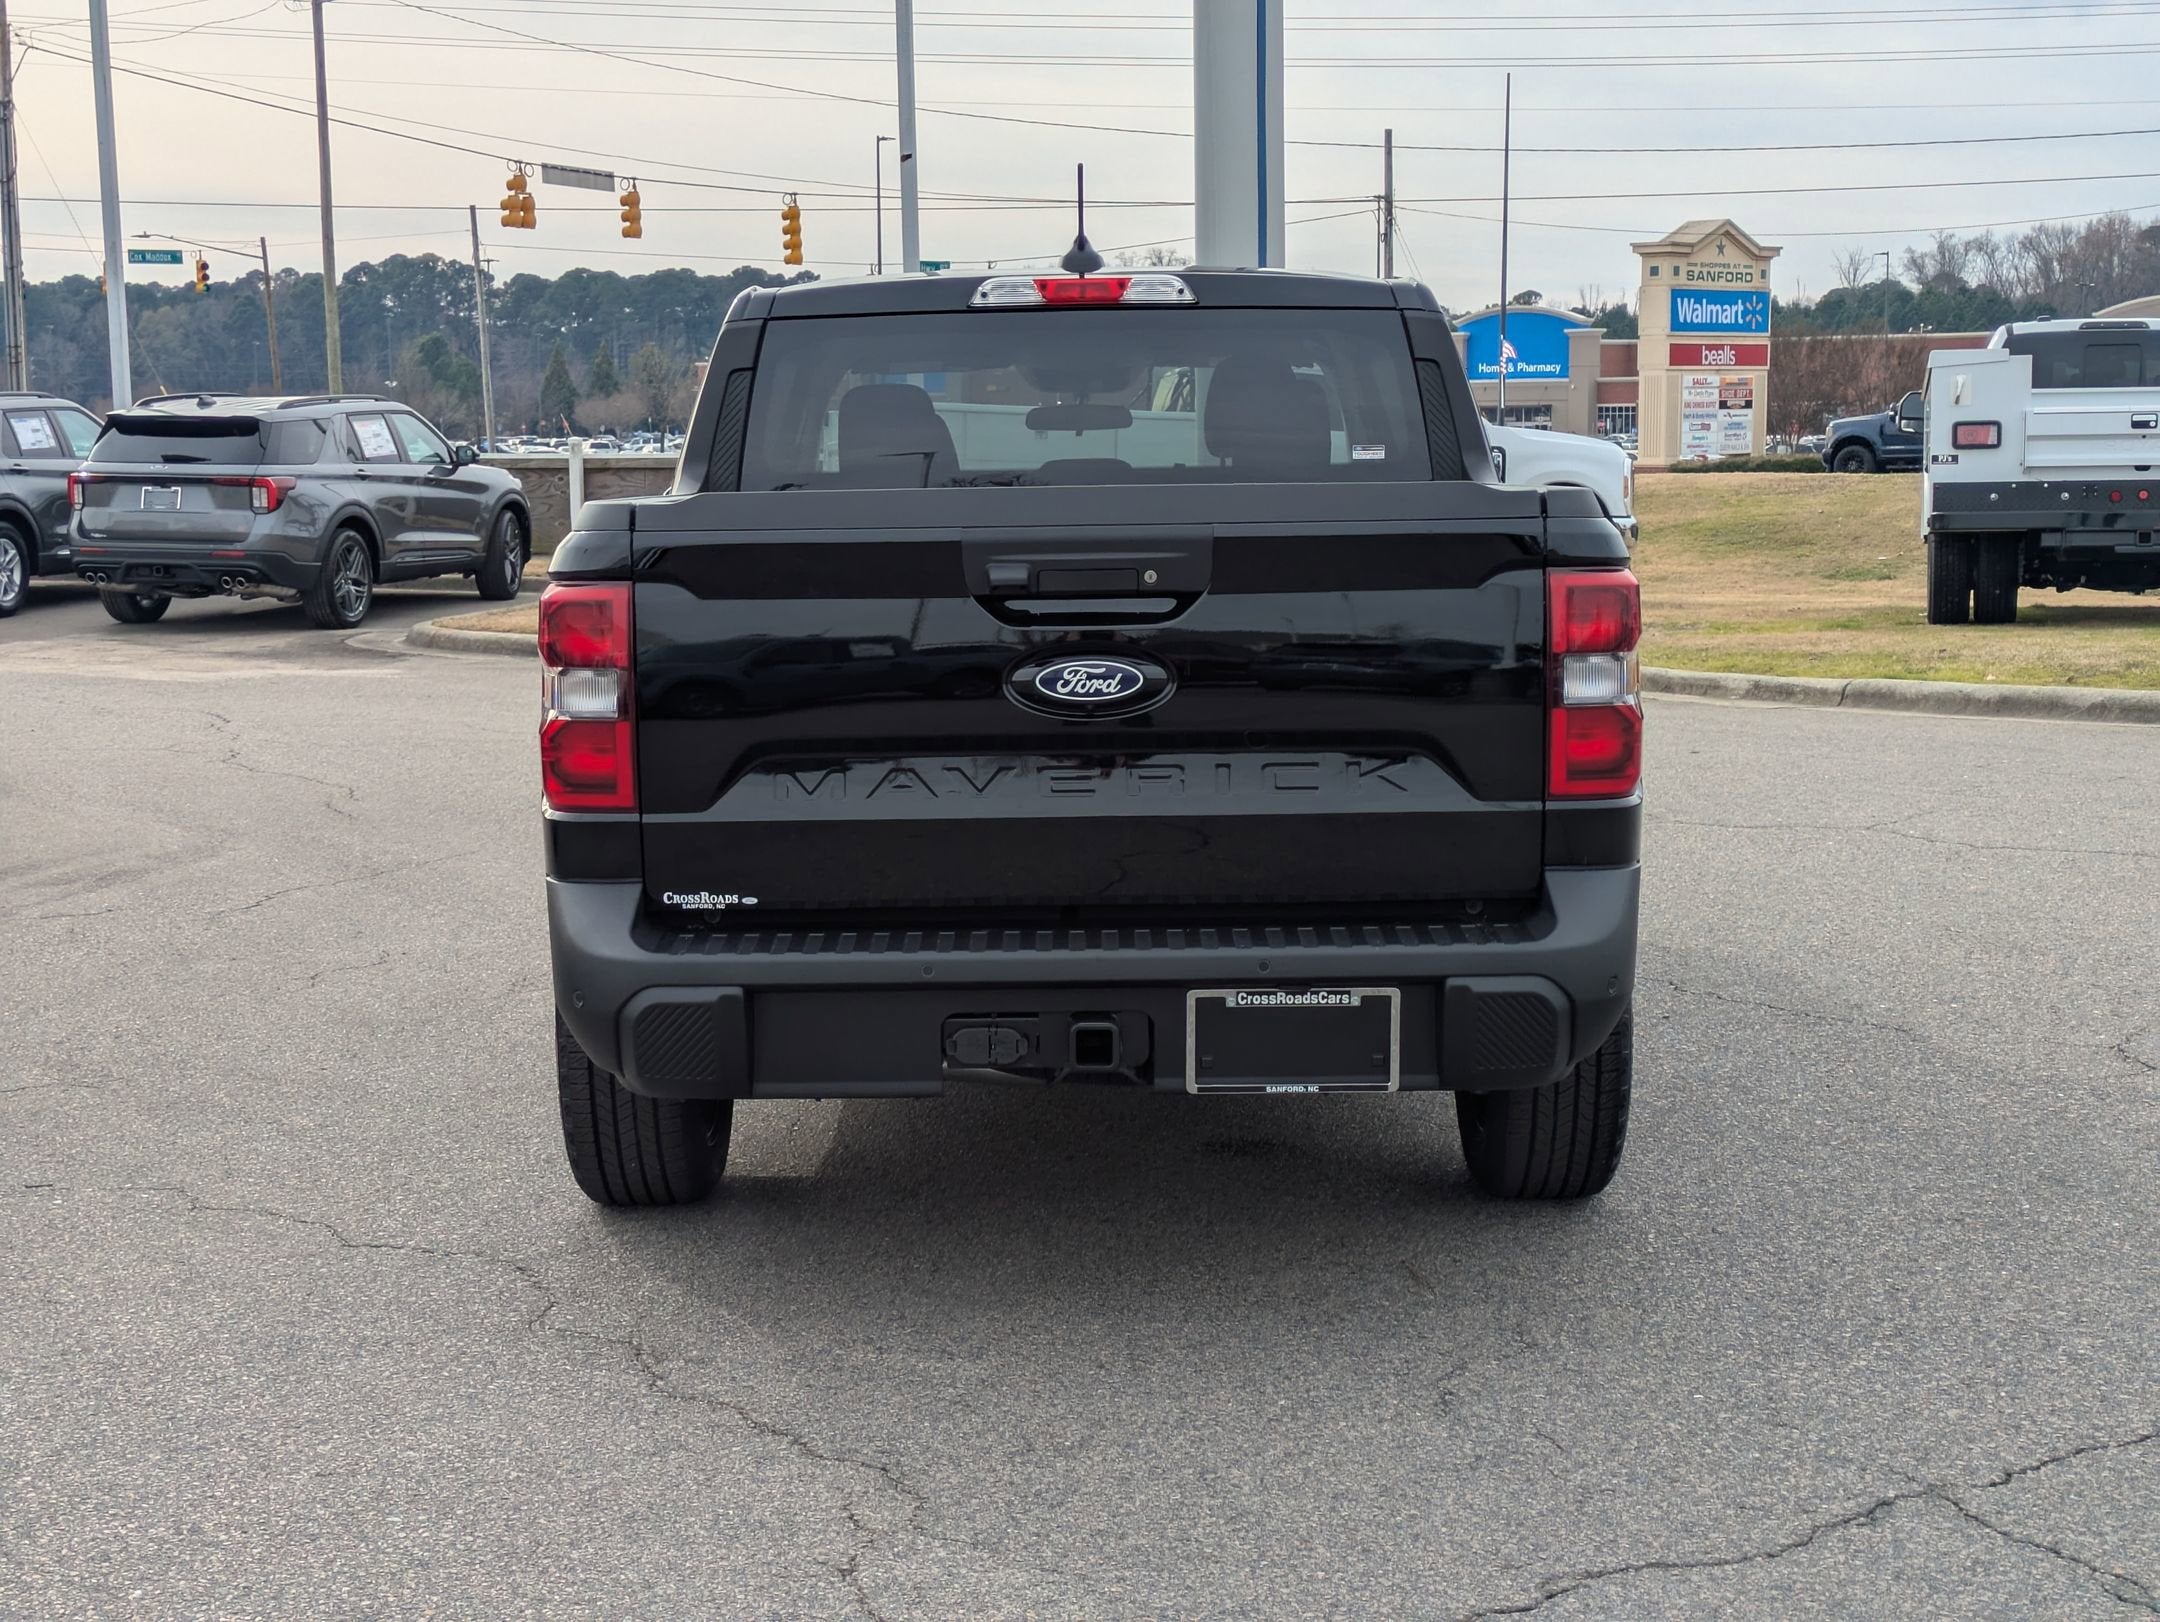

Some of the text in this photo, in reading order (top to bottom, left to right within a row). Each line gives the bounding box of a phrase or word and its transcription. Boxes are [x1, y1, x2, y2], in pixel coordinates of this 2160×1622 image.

[130, 252, 143, 261] Cox
[145, 252, 172, 261] Maddox
[1686, 270, 1754, 283] SANFORD
[1677, 297, 1744, 324] Walmart
[1702, 345, 1736, 365] bealls
[1478, 362, 1503, 374] Hom
[1517, 362, 1562, 375] Pharmacy
[1056, 666, 1123, 694] Ford
[773, 758, 1412, 800] MAVERICK
[1237, 991, 1350, 1005] CrossRoadsCars
